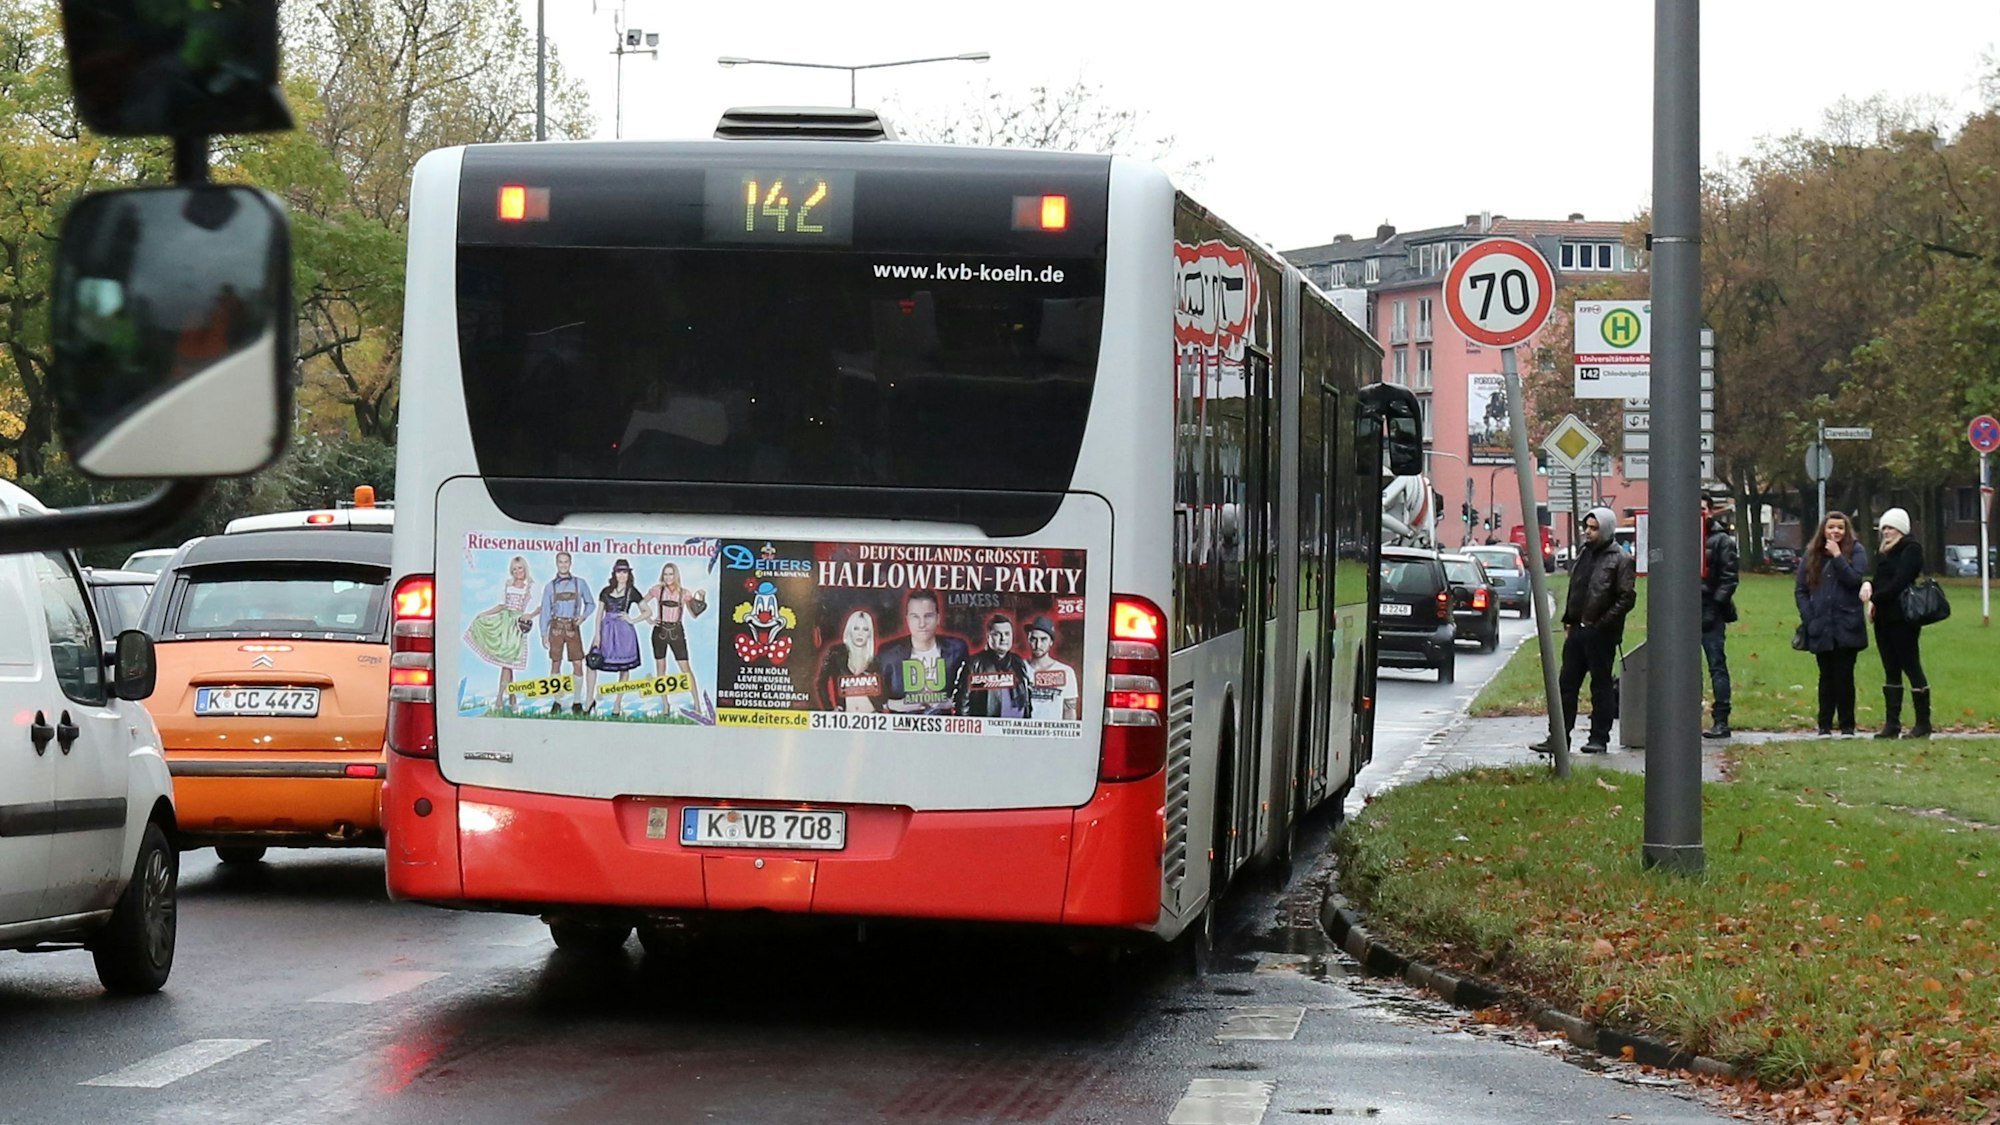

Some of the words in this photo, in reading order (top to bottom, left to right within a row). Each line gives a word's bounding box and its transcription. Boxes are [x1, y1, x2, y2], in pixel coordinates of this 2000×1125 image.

[746, 181, 828, 232] 142
[873, 262, 1064, 282] www.kvb-koeln.de
[1469, 269, 1529, 321] 70
[1612, 317, 1630, 340] H
[1582, 370, 1599, 378] 142
[468, 534, 579, 552] Riesenauswahl
[583, 541, 601, 553] an
[604, 538, 715, 557] Trachtenmode
[859, 545, 971, 563] DEUTSCHLANDS
[975, 548, 1039, 565] GRÖSSTE
[817, 560, 1082, 594] HALLOWEEN-PARTY
[948, 594, 1000, 607] LANXESS
[1058, 604, 1074, 614] 20
[765, 667, 788, 675] KÖLN
[902, 658, 947, 692] DJ
[737, 675, 790, 684] LEVERKUSEN
[840, 676, 878, 687] HANNA
[508, 682, 535, 692] Dirndl
[600, 681, 651, 694] Lederhosen
[764, 683, 794, 692] DÜREN
[209, 692, 222, 709] K
[235, 692, 260, 709] CC
[265, 692, 315, 710] 4473
[718, 690, 760, 698] BERGISCH
[761, 692, 809, 700] GLADBACH
[904, 692, 948, 704] ANTOINE
[735, 699, 791, 708] DÜSSELDORF
[718, 712, 807, 726] www.deiters.de
[812, 713, 887, 731] 31.10.2012
[892, 716, 942, 732] LANXESS
[945, 718, 981, 734] arena
[987, 719, 1012, 727] TICKETS
[1013, 720, 1021, 728] AN
[1044, 721, 1080, 729] BEKANNTEN
[1002, 728, 1080, 737] VORVERKAUFS-STELLEN
[708, 813, 725, 837] K
[744, 814, 776, 839] VB
[784, 816, 832, 840] 708
